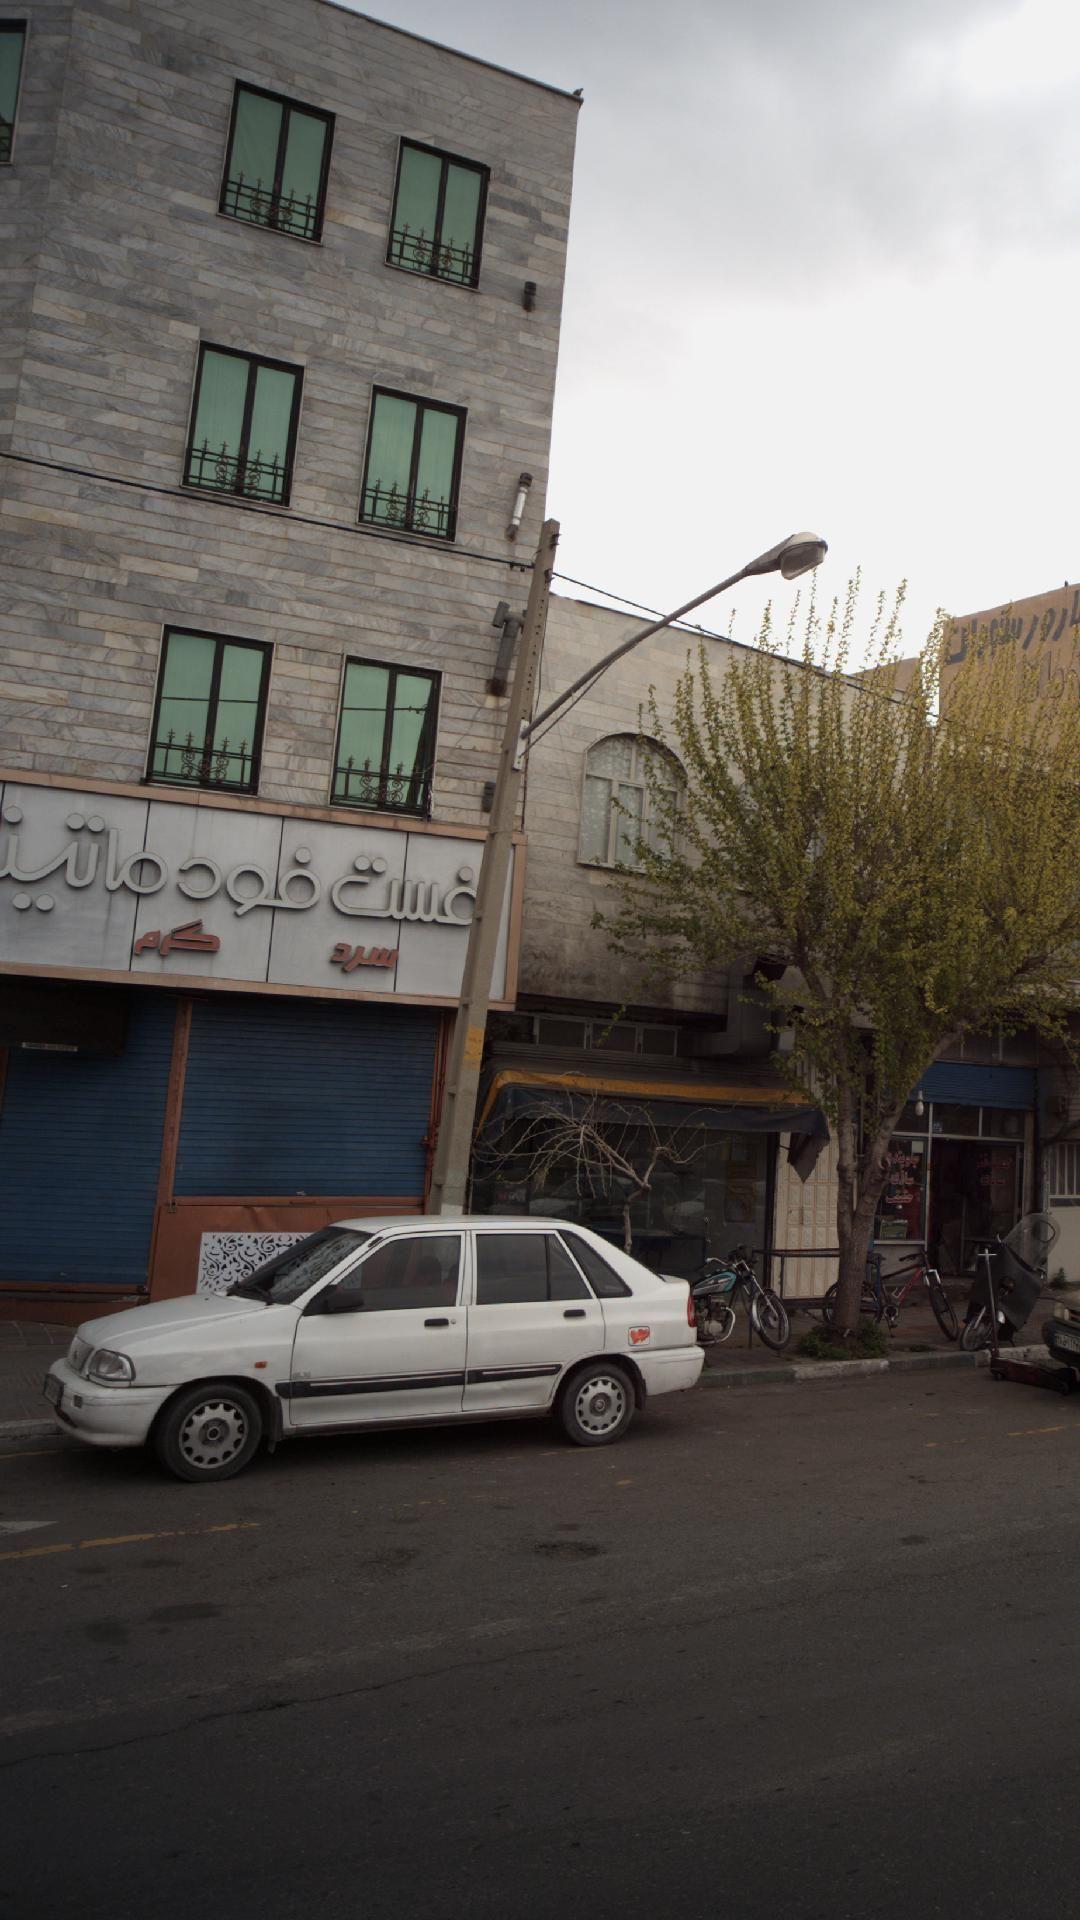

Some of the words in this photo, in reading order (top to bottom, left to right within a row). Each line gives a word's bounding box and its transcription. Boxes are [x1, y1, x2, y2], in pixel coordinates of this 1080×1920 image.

[178, 847, 321, 917] فود
[332, 855, 477, 925] فست
[134, 919, 221, 957] گرم
[329, 942, 399, 973] سرد
